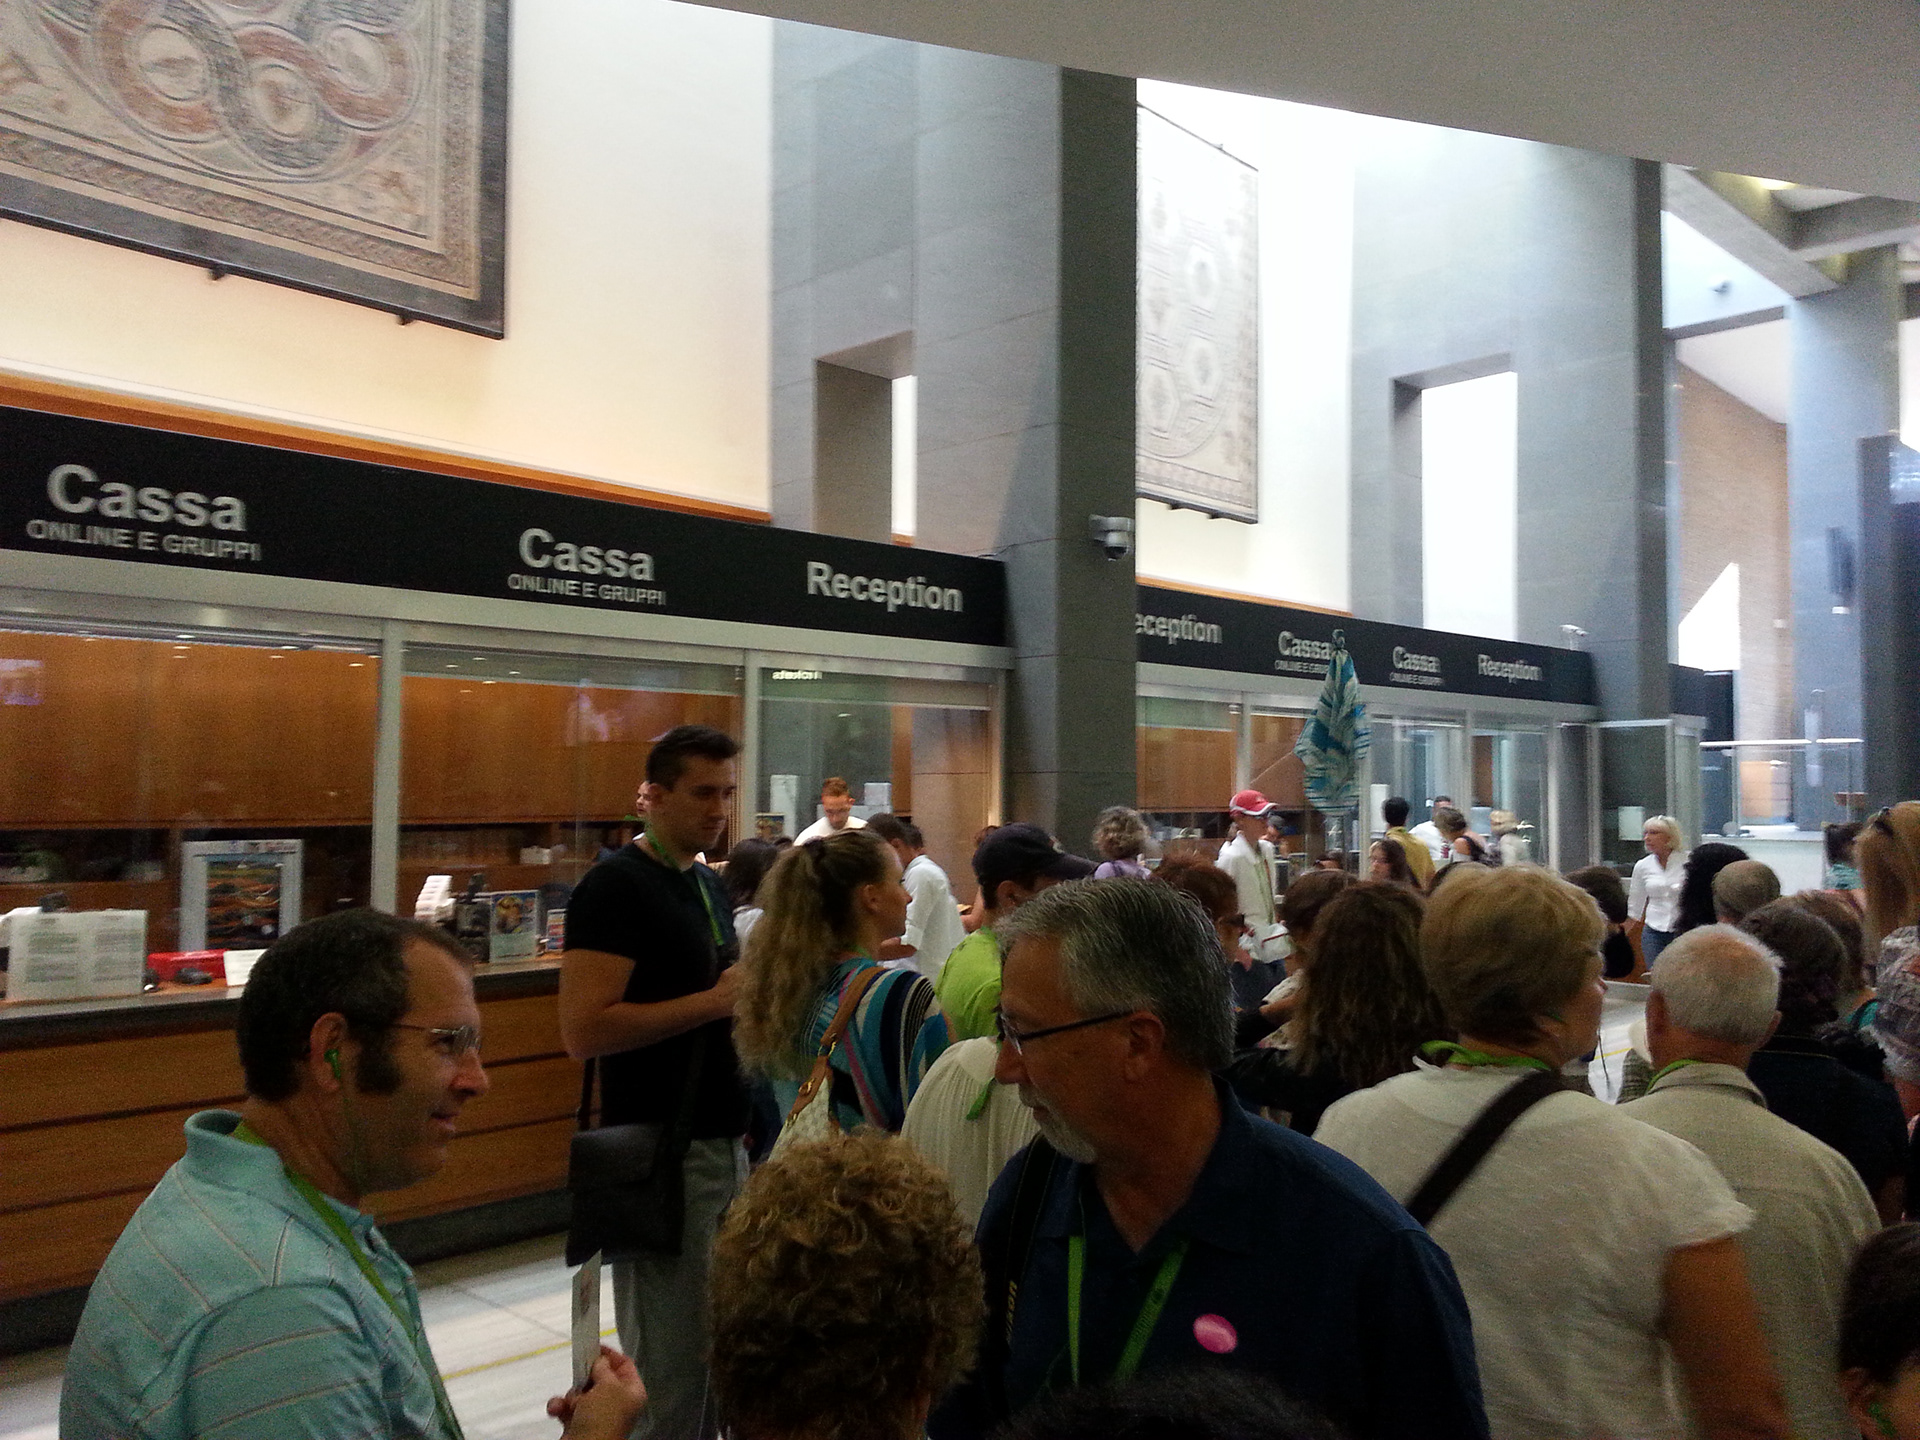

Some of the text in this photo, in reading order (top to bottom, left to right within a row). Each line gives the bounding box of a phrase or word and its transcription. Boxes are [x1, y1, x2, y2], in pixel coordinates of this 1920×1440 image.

[47, 463, 248, 531] Cassa
[26, 519, 262, 561] ONLINE E GRUPPI
[519, 528, 655, 581] Cassa
[507, 573, 666, 606] ONLINE E GRUPPI
[807, 561, 964, 612] Reception
[1135, 613, 1222, 645] eception
[1278, 630, 1333, 660] Cassa
[1393, 646, 1441, 673] Cassa
[1478, 654, 1542, 684] Reception
